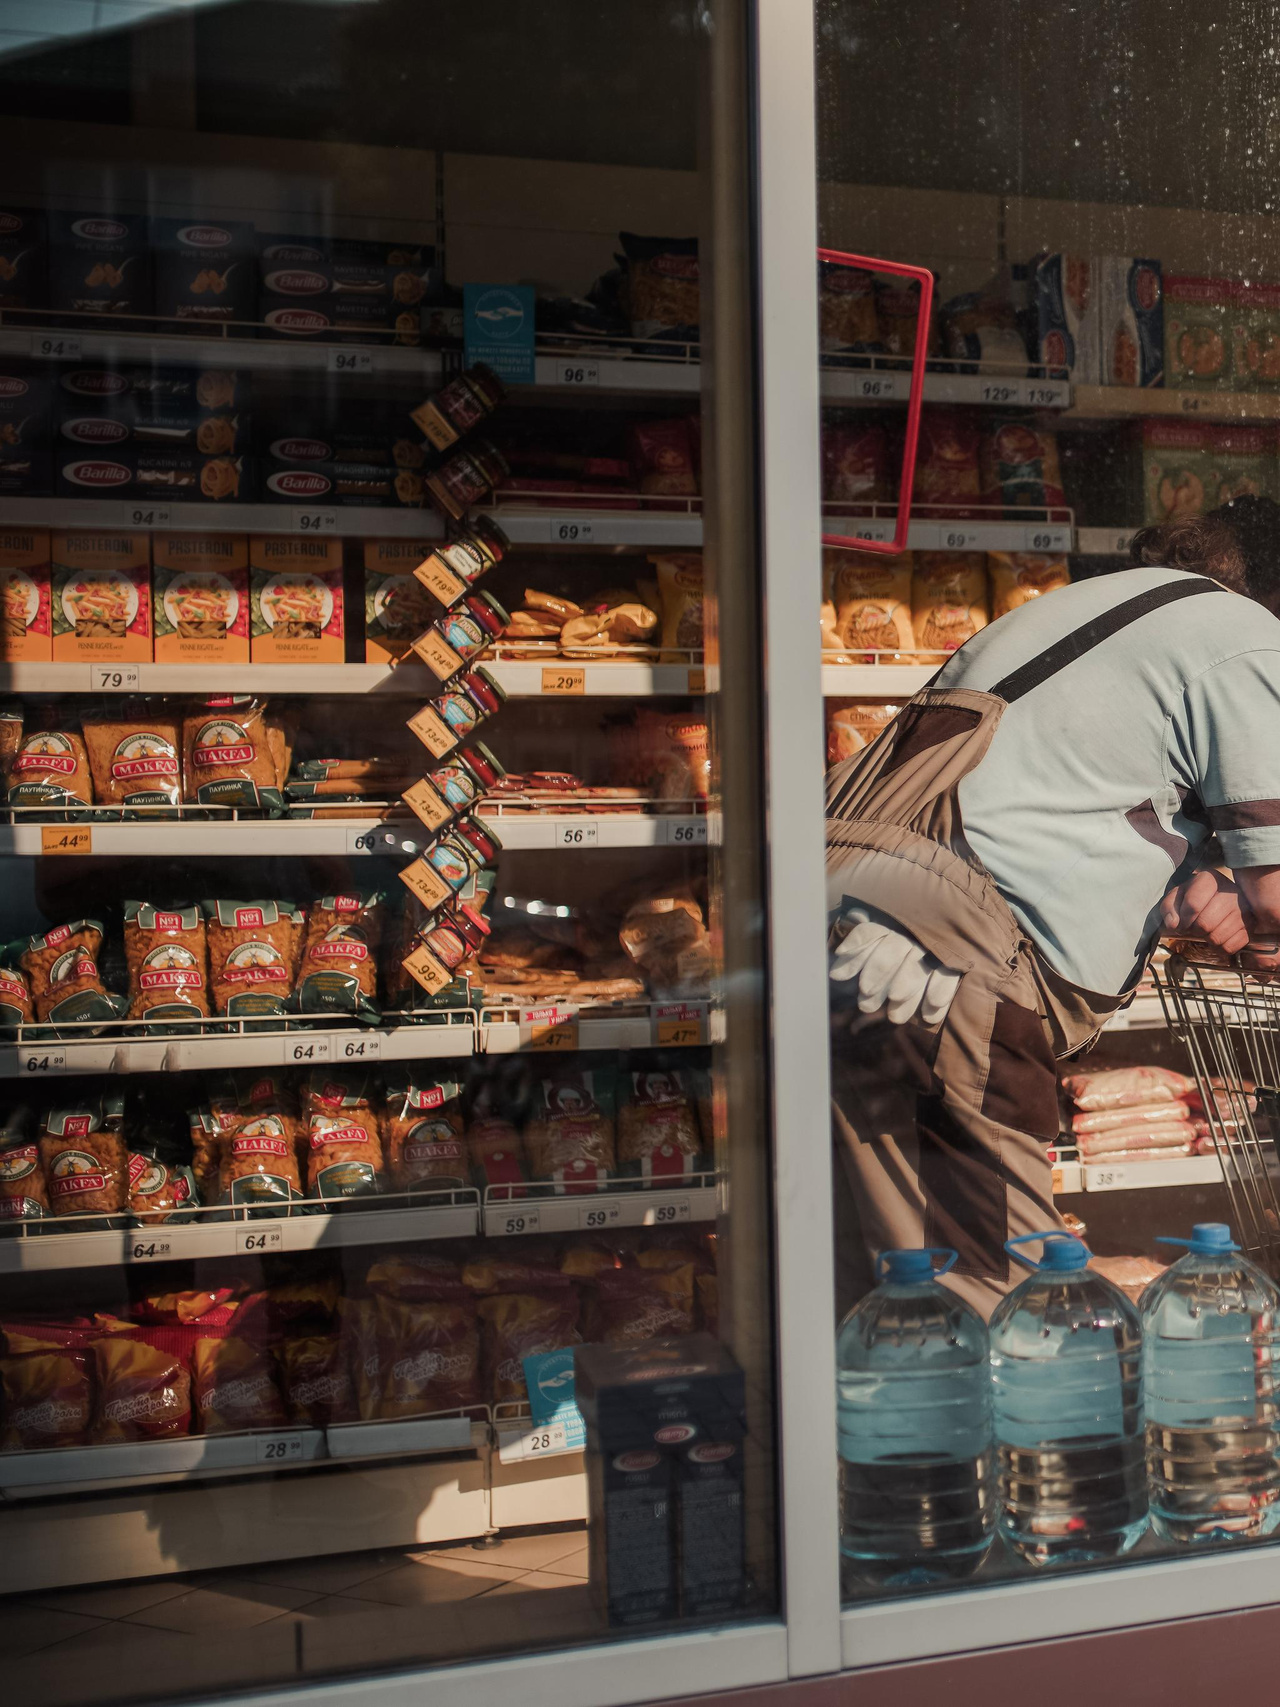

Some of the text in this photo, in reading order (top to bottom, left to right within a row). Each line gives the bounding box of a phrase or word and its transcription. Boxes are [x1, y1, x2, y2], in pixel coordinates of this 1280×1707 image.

[84, 222, 123, 235] Barilla
[188, 229, 228, 243] Barilla
[279, 275, 324, 289] Barilla
[280, 314, 325, 328] Barilla
[41, 340, 65, 356] 94
[335, 354, 370, 369] 94 99
[564, 368, 584, 382] 96
[862, 382, 881, 395] 96
[983, 387, 1009, 400] 129
[77, 423, 124, 438] Barilla
[284, 442, 327, 456] Barilla
[79, 465, 126, 480] Barilla
[457, 460, 484, 487] DOLMIO
[281, 477, 327, 491] Barilla
[132, 510, 169, 525] 94 99
[299, 514, 335, 530] 94 99
[559, 525, 579, 539] 69
[947, 533, 965, 546] 69
[0, 535, 34, 553] ERONI
[66, 537, 134, 555] PASTERONI
[168, 539, 234, 557] PASTERONI
[1032, 534, 1051, 548] 69
[264, 541, 328, 558] PASTERONI
[99, 672, 137, 688] 79 99
[556, 677, 574, 689] 29
[197, 749, 247, 762] MAKFA
[17, 756, 69, 771] MAKFA
[119, 760, 171, 775] MAKFA
[19, 786, 54, 794] ПАУТИНКА
[208, 782, 241, 793] ПАУТИНКА
[131, 796, 165, 804] ПАУТИНКА
[58, 835, 79, 848] 44
[563, 829, 584, 843] 56
[674, 827, 694, 841] 56
[354, 835, 376, 850] 69
[314, 944, 362, 958] MAKFA
[144, 973, 197, 986] MAKFA
[417, 963, 436, 982] 99
[0, 980, 23, 996] KFA
[545, 1033, 562, 1046] 47
[671, 1030, 688, 1043] 47
[293, 1045, 314, 1060] 64
[344, 1042, 365, 1057] 64
[27, 1056, 64, 1072] 64 99
[236, 1139, 286, 1153] MAKFA
[410, 1144, 459, 1159] MAKFA
[1096, 1173, 1114, 1186] 38
[586, 1211, 606, 1226] 59
[657, 1206, 676, 1221] 59
[506, 1218, 525, 1233] 59
[245, 1234, 267, 1250] 64
[134, 1243, 156, 1258] 64
[105, 1394, 149, 1420] Просто
[531, 1433, 551, 1451] 28
[265, 1441, 300, 1459] 28 99
